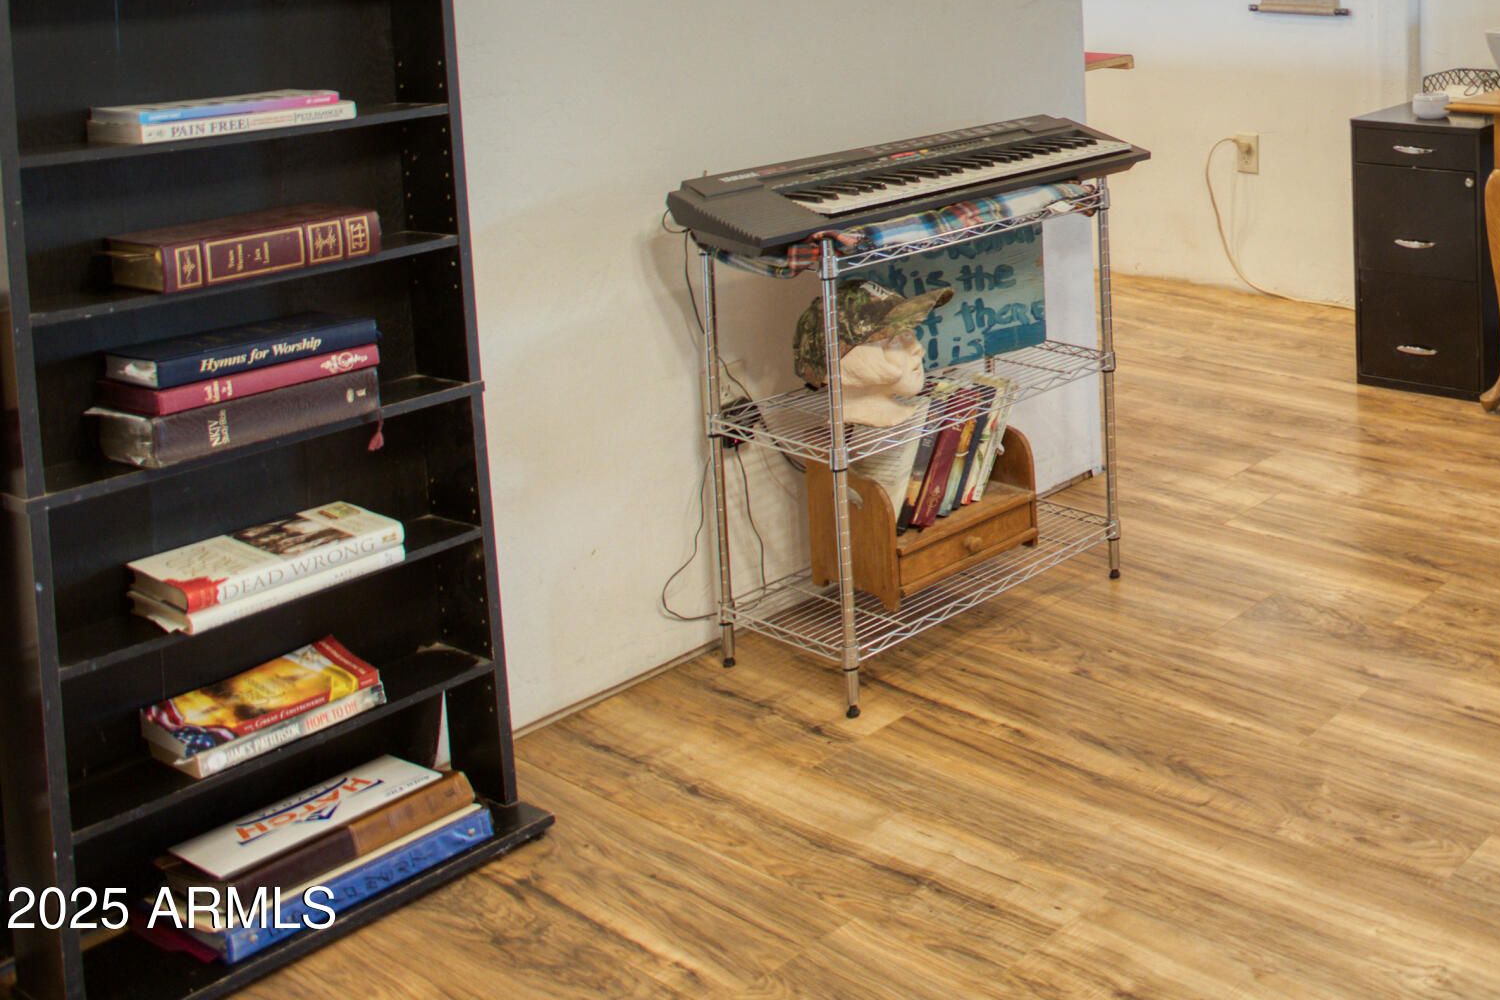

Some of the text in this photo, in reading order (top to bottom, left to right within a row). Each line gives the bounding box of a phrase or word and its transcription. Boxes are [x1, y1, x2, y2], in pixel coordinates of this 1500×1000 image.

[170, 119, 248, 138] PAIN FREE
[956, 263, 1017, 292] the
[200, 336, 322, 373] Hymns for Worship
[223, 537, 375, 600] DEAD WRONG
[304, 700, 360, 731] HOPE TO DIE
[253, 721, 300, 752] PATTERSON
[235, 776, 372, 842] HATCH
